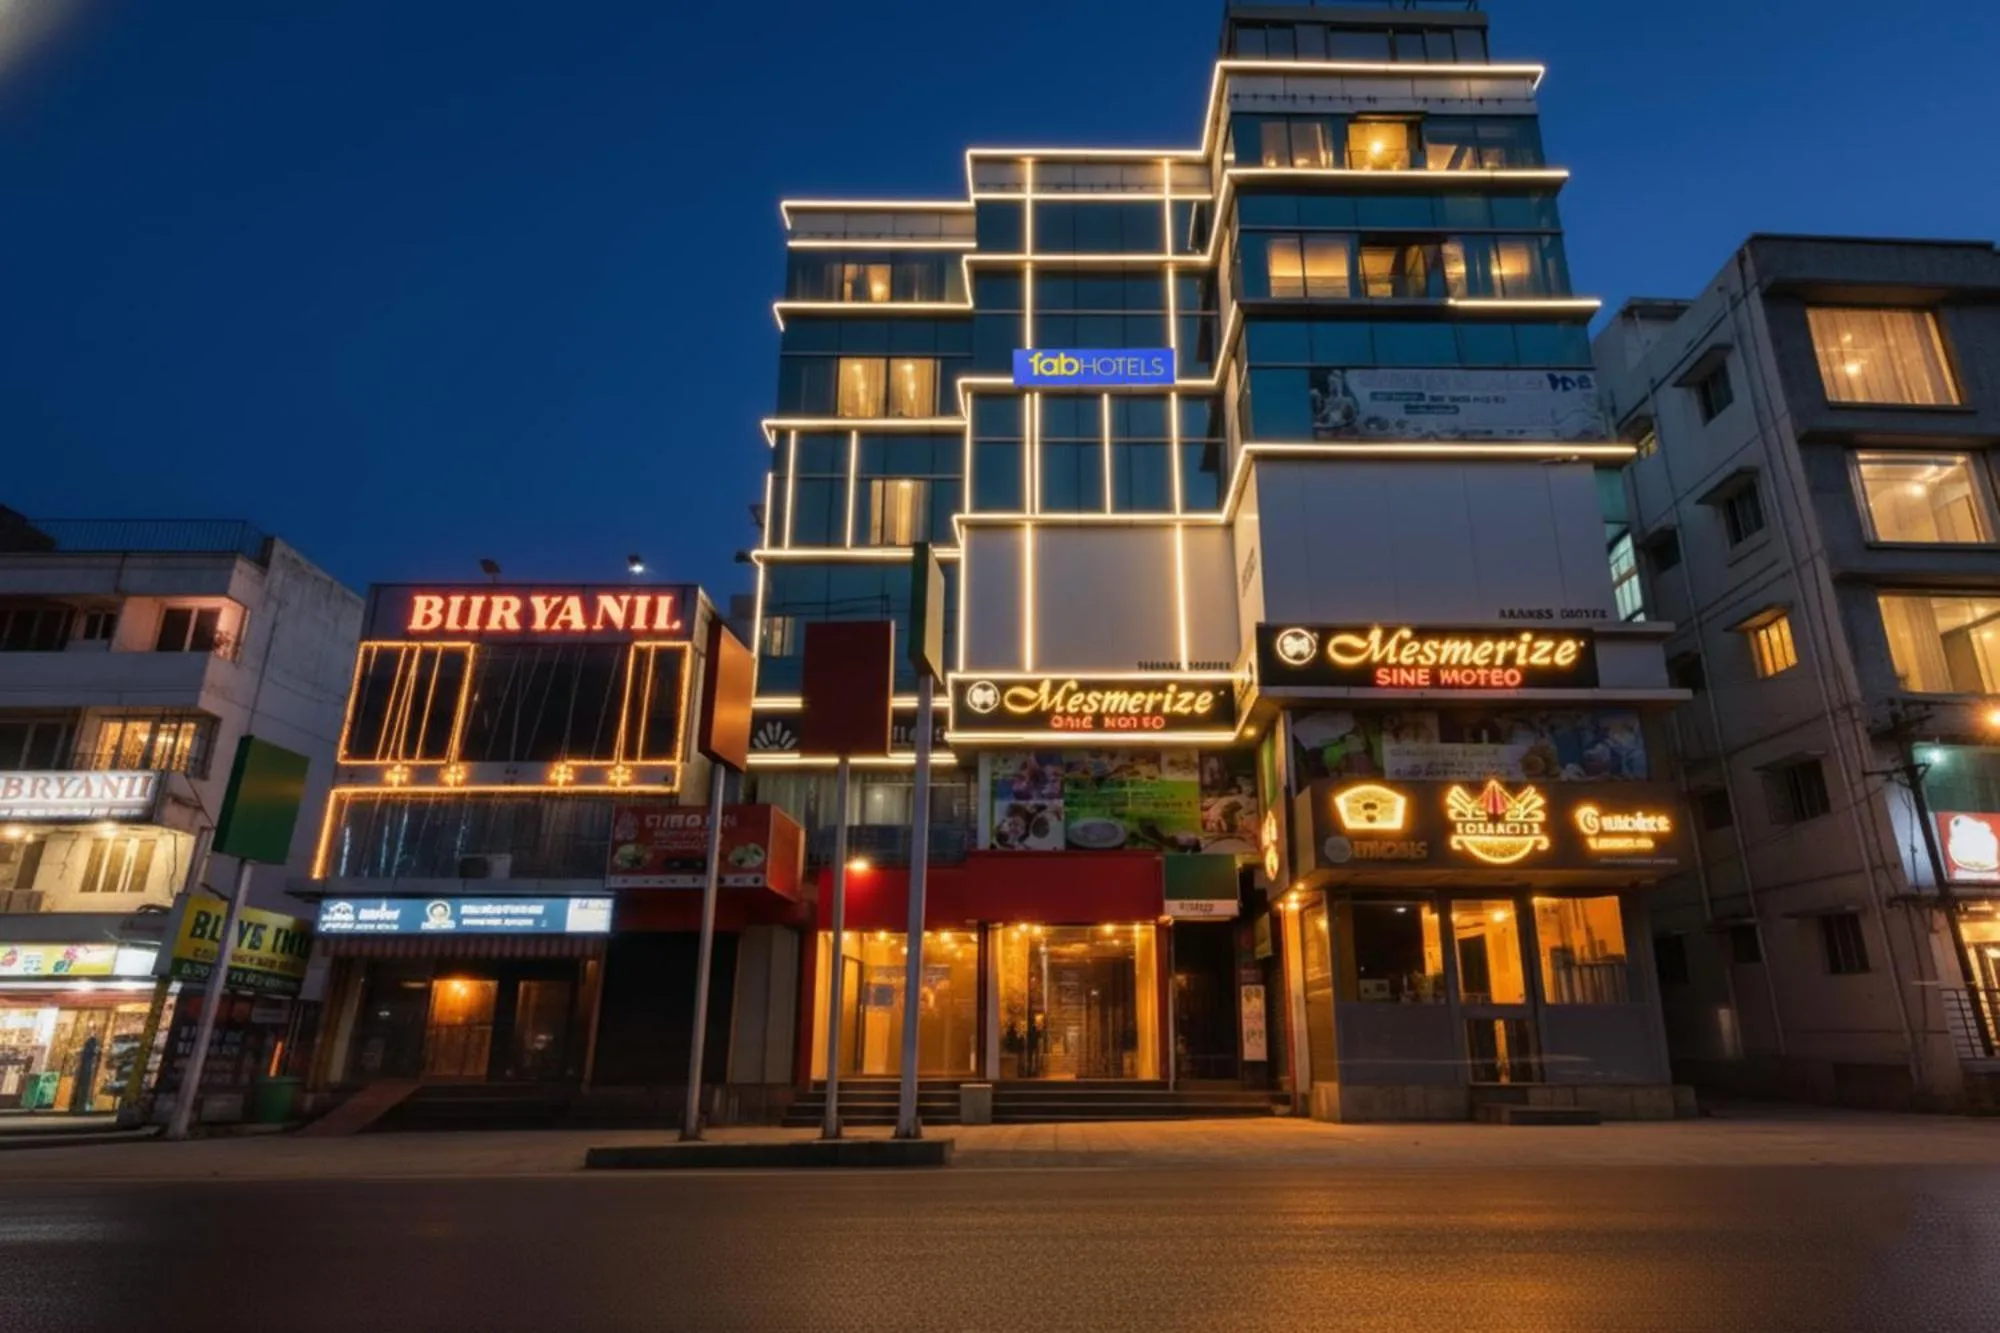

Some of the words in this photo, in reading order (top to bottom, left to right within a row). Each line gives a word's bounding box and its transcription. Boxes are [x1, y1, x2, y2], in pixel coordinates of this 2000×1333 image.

[1327, 626, 1578, 667] Mesmerize
[1375, 668, 1431, 686] SINE
[1004, 679, 1214, 714] Mesmerize
